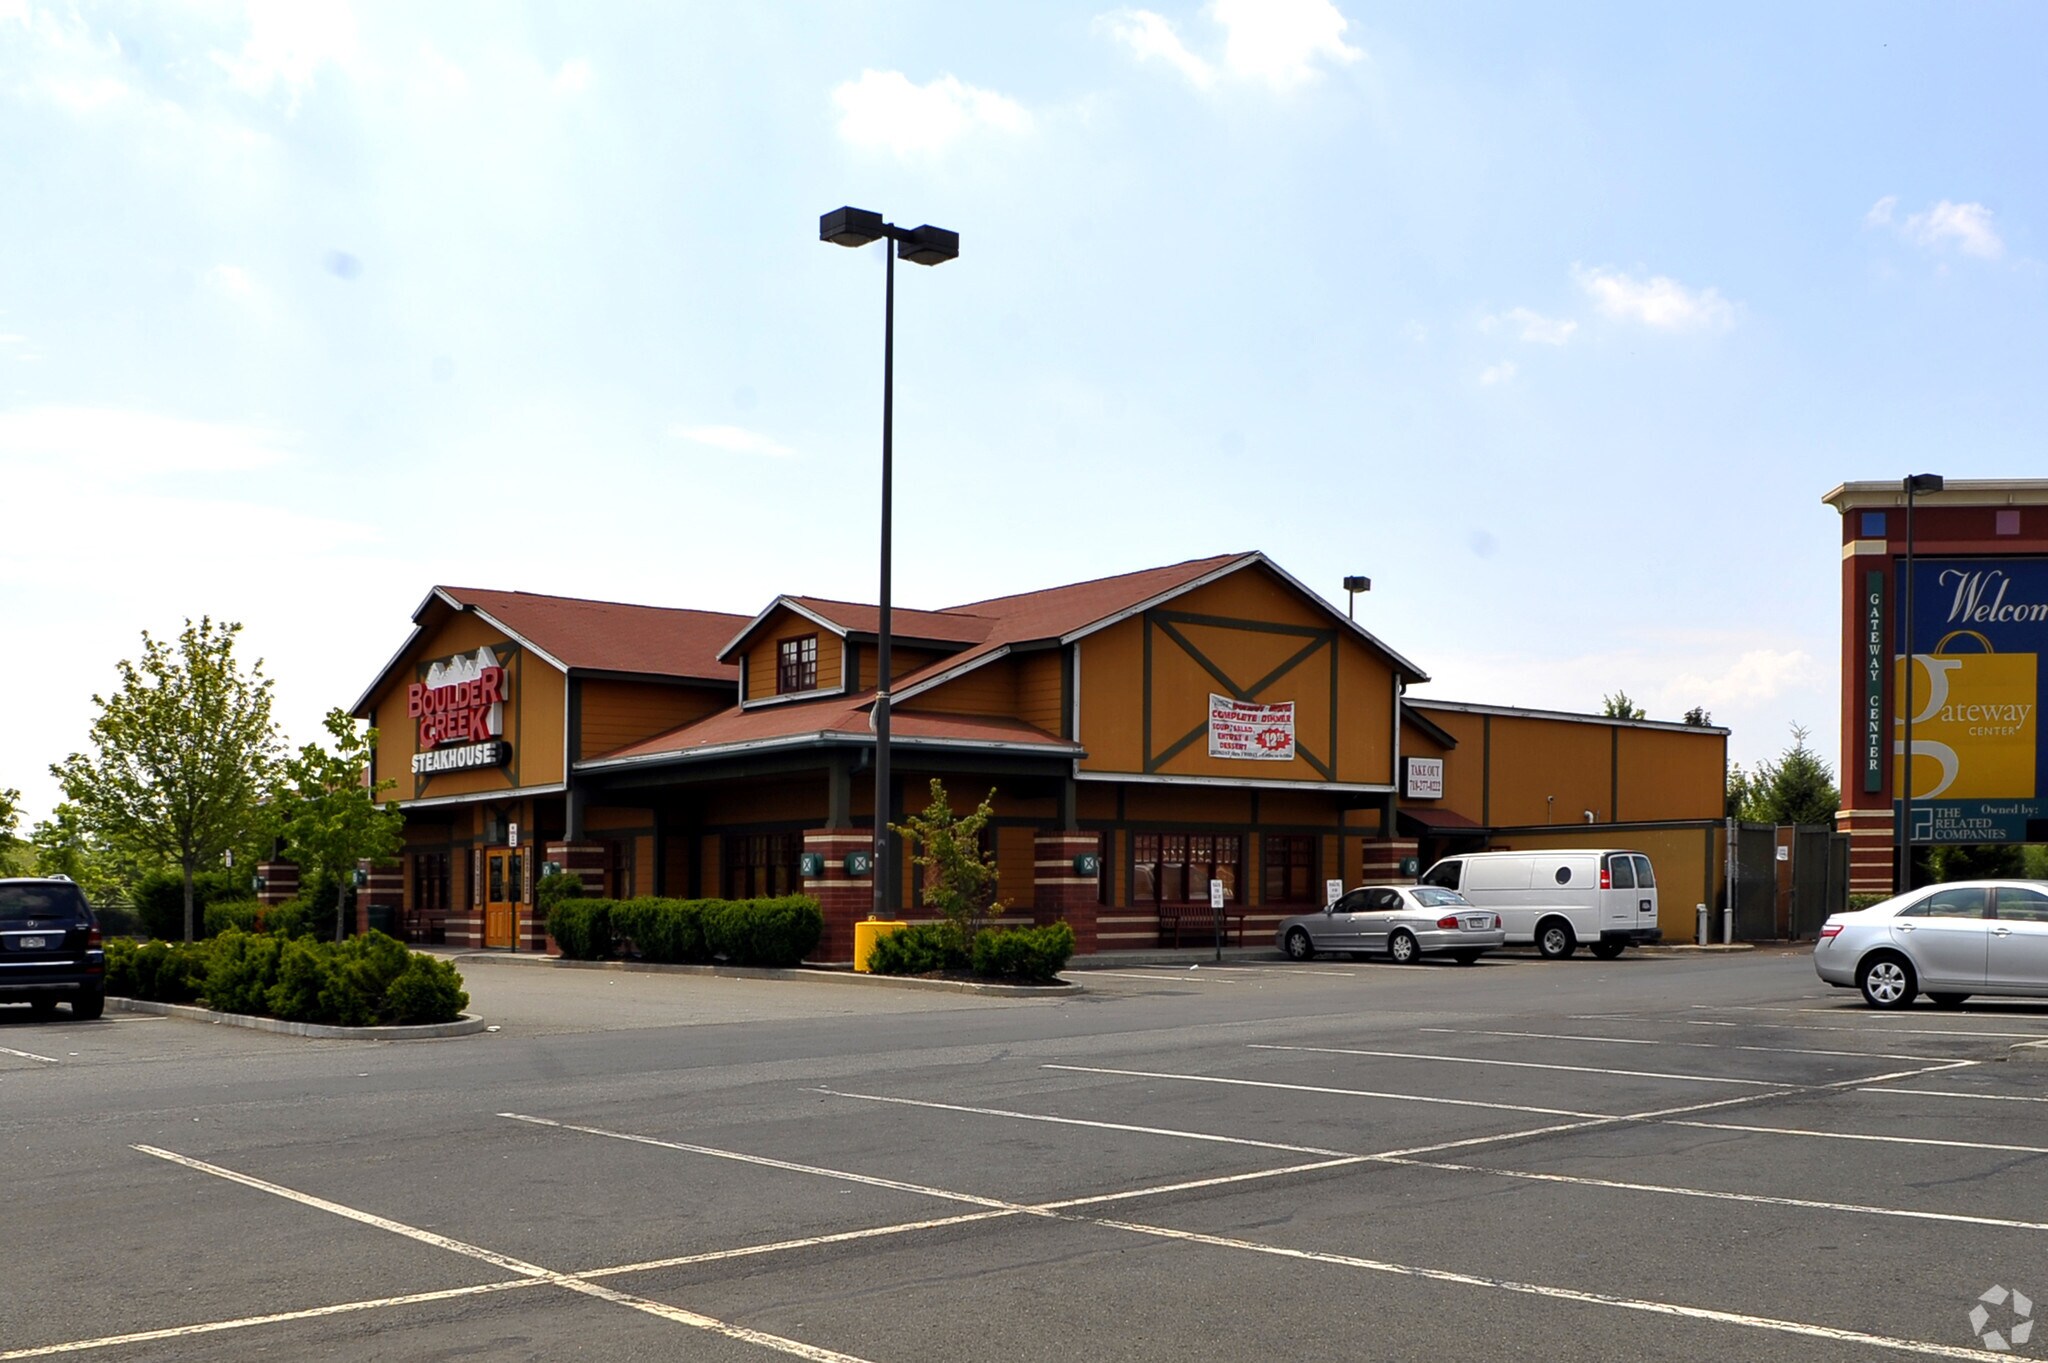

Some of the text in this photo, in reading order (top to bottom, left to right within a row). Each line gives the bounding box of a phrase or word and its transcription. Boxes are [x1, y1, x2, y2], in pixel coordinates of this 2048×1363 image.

[1869, 593, 1881, 770] GATEWAY CENTER
[408, 666, 503, 719] BOULDER
[1212, 709, 1292, 723] COMPLETE DINNER
[420, 705, 491, 749] CREEK
[1968, 726, 2015, 736] CENTER
[411, 743, 496, 774] STEAKHOUSE
[1936, 808, 1961, 818] THE
[1981, 804, 2039, 817] Owned by:
[1935, 818, 1993, 829] RELATED
[1935, 829, 2007, 840] COMPANIES
